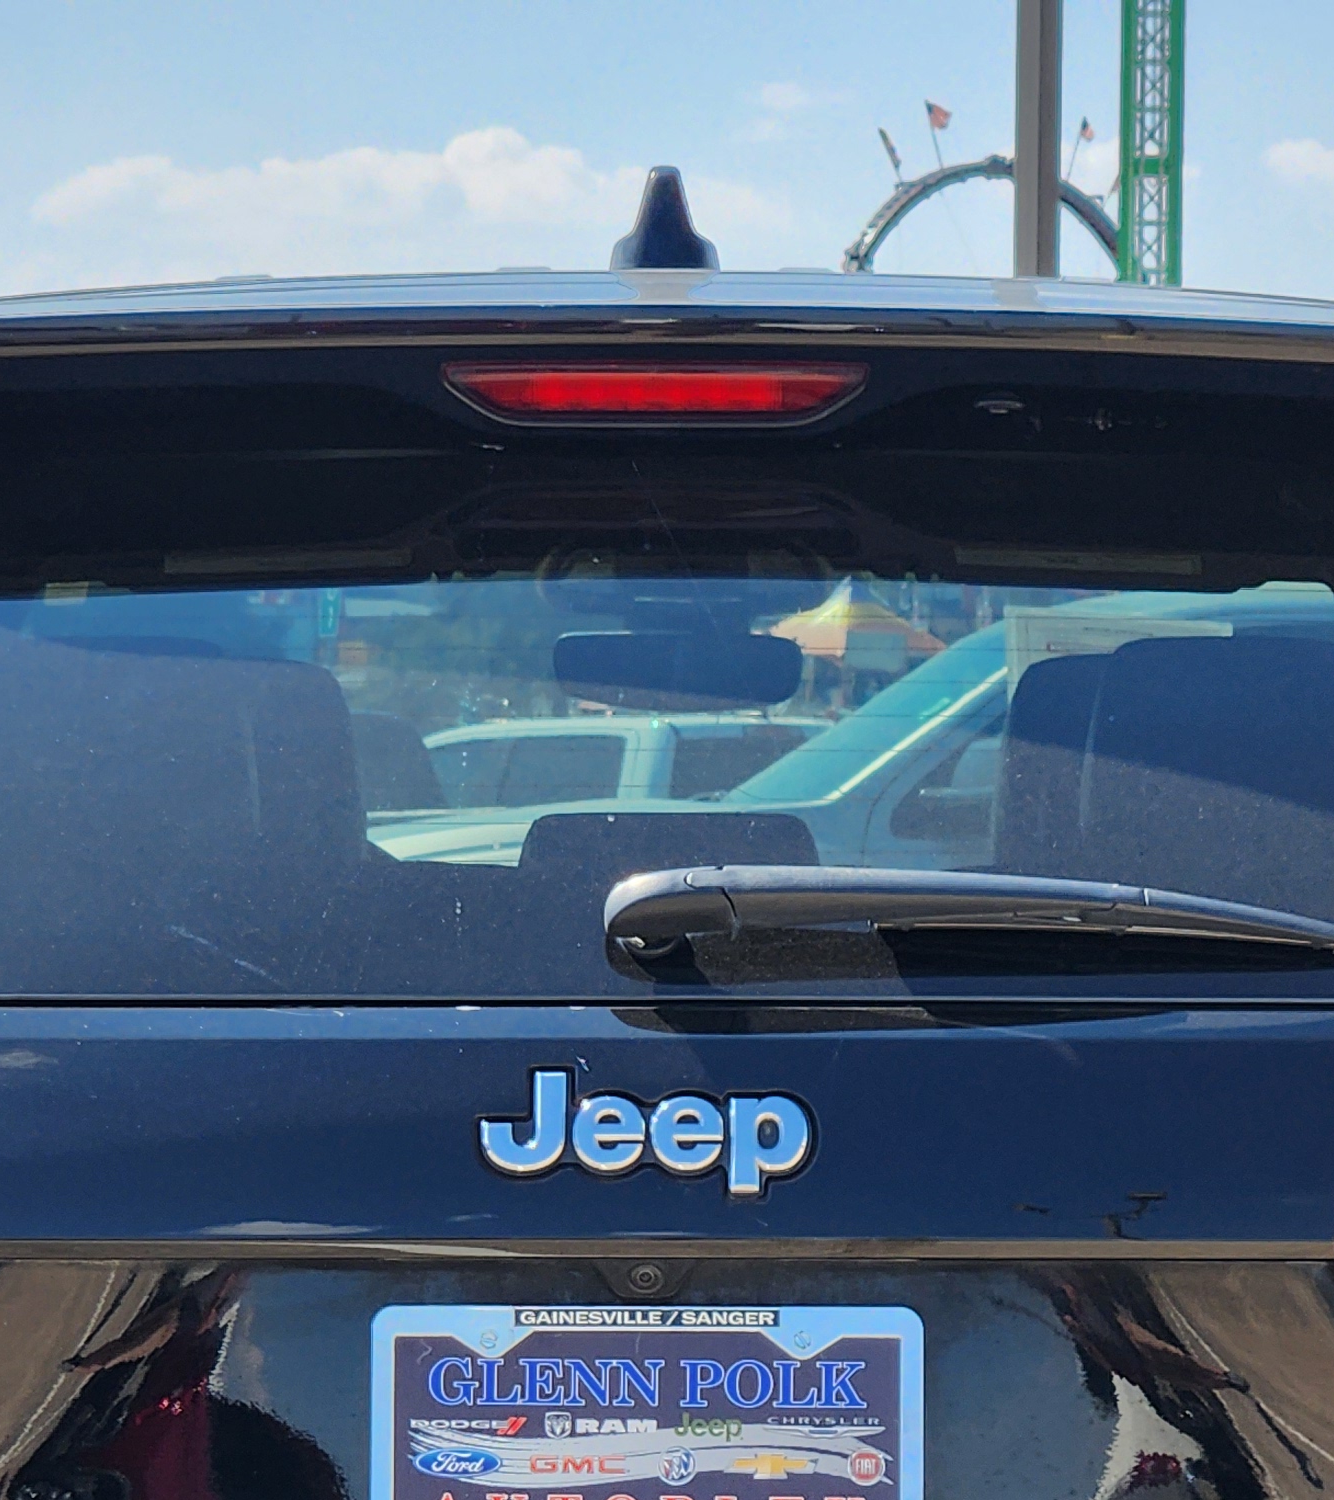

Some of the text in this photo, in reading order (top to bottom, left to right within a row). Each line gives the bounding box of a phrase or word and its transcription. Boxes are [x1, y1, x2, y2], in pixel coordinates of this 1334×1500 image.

[480, 1070, 809, 1194] Jeep
[520, 1310, 662, 1326] GAINESVILLE
[681, 1310, 775, 1326] SANGER
[428, 1356, 868, 1409] GLENN POLK
[410, 1418, 508, 1430] DODGE
[575, 1417, 658, 1434] RAM
[674, 1412, 743, 1442] Jeep
[766, 1416, 881, 1426] CHRYSLER
[430, 1451, 485, 1474] Ford
[529, 1454, 626, 1475] GMC
[855, 1458, 877, 1475] FIAT
